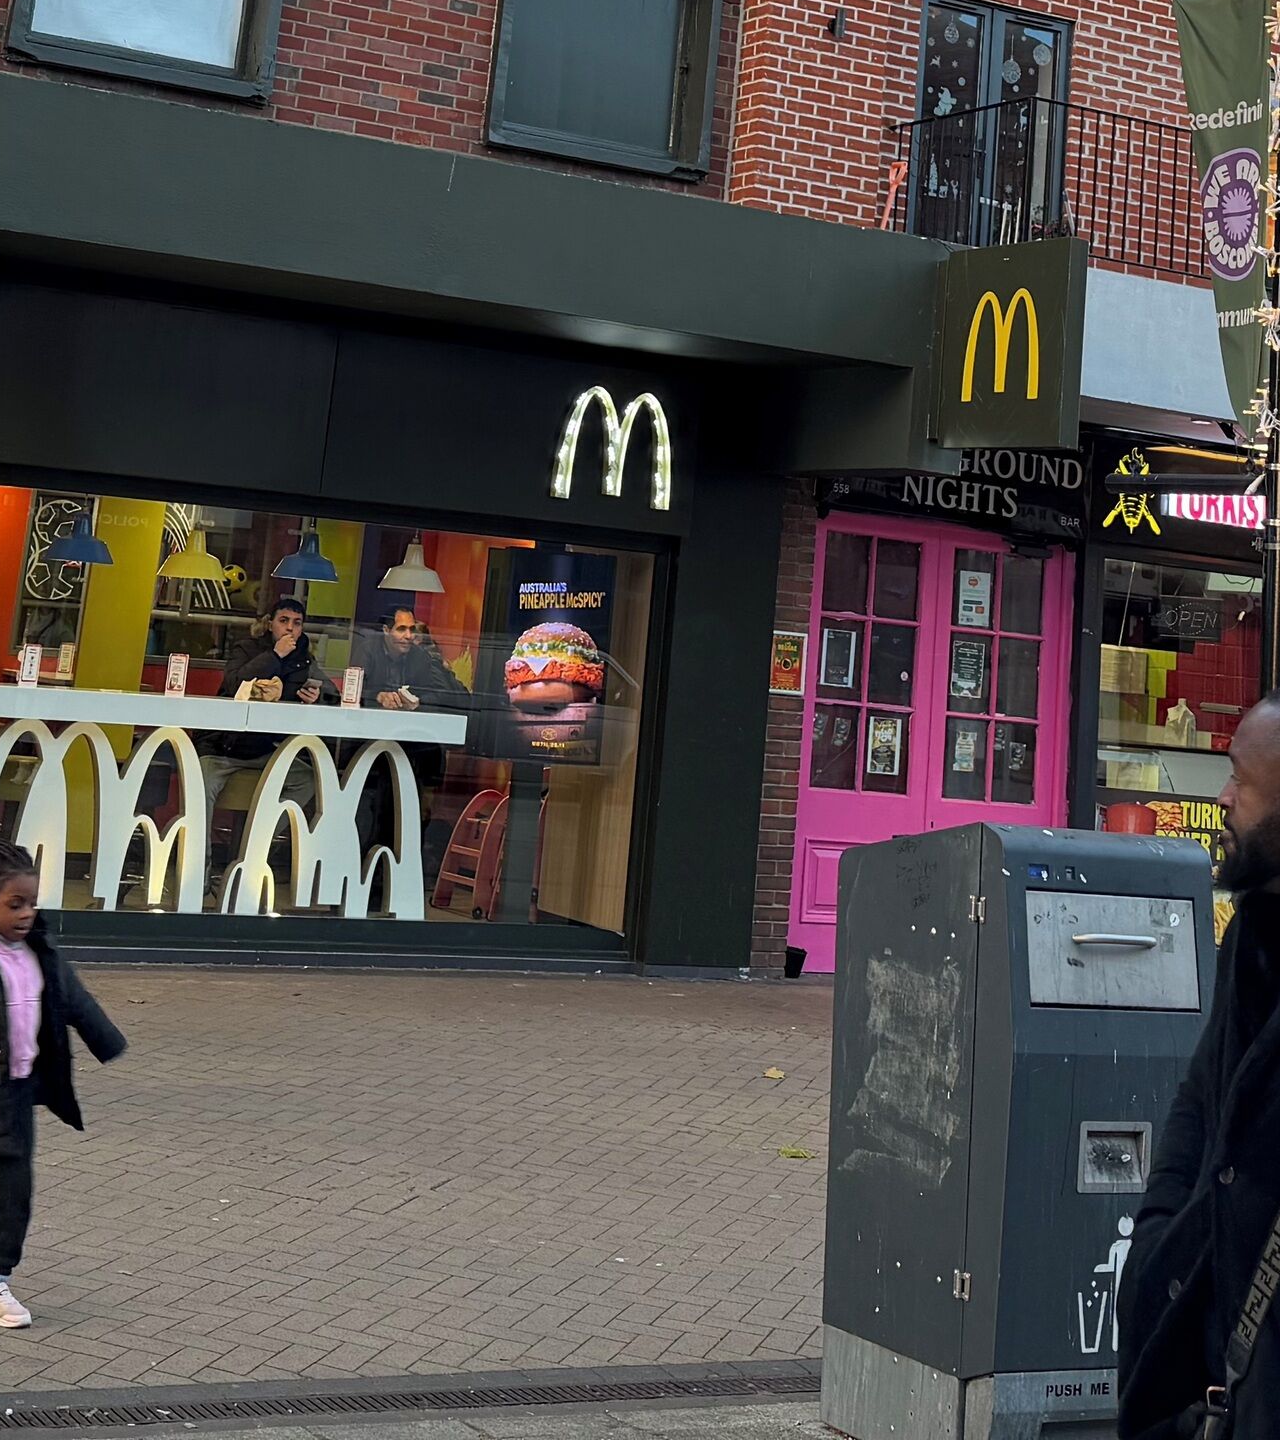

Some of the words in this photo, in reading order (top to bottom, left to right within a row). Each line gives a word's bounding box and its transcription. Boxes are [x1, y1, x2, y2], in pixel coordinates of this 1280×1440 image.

[1204, 164, 1231, 208] WE
[832, 482, 850, 494] 558
[901, 475, 1018, 518] NIGHTS
[1060, 516, 1081, 528] BAR
[519, 582, 568, 594] AUSTRALIA'S
[519, 592, 566, 610] PINEAPPLE
[1165, 610, 1219, 629] OPEN
[1046, 1383, 1083, 1398] PUSH
[1090, 1382, 1110, 1396] ME
